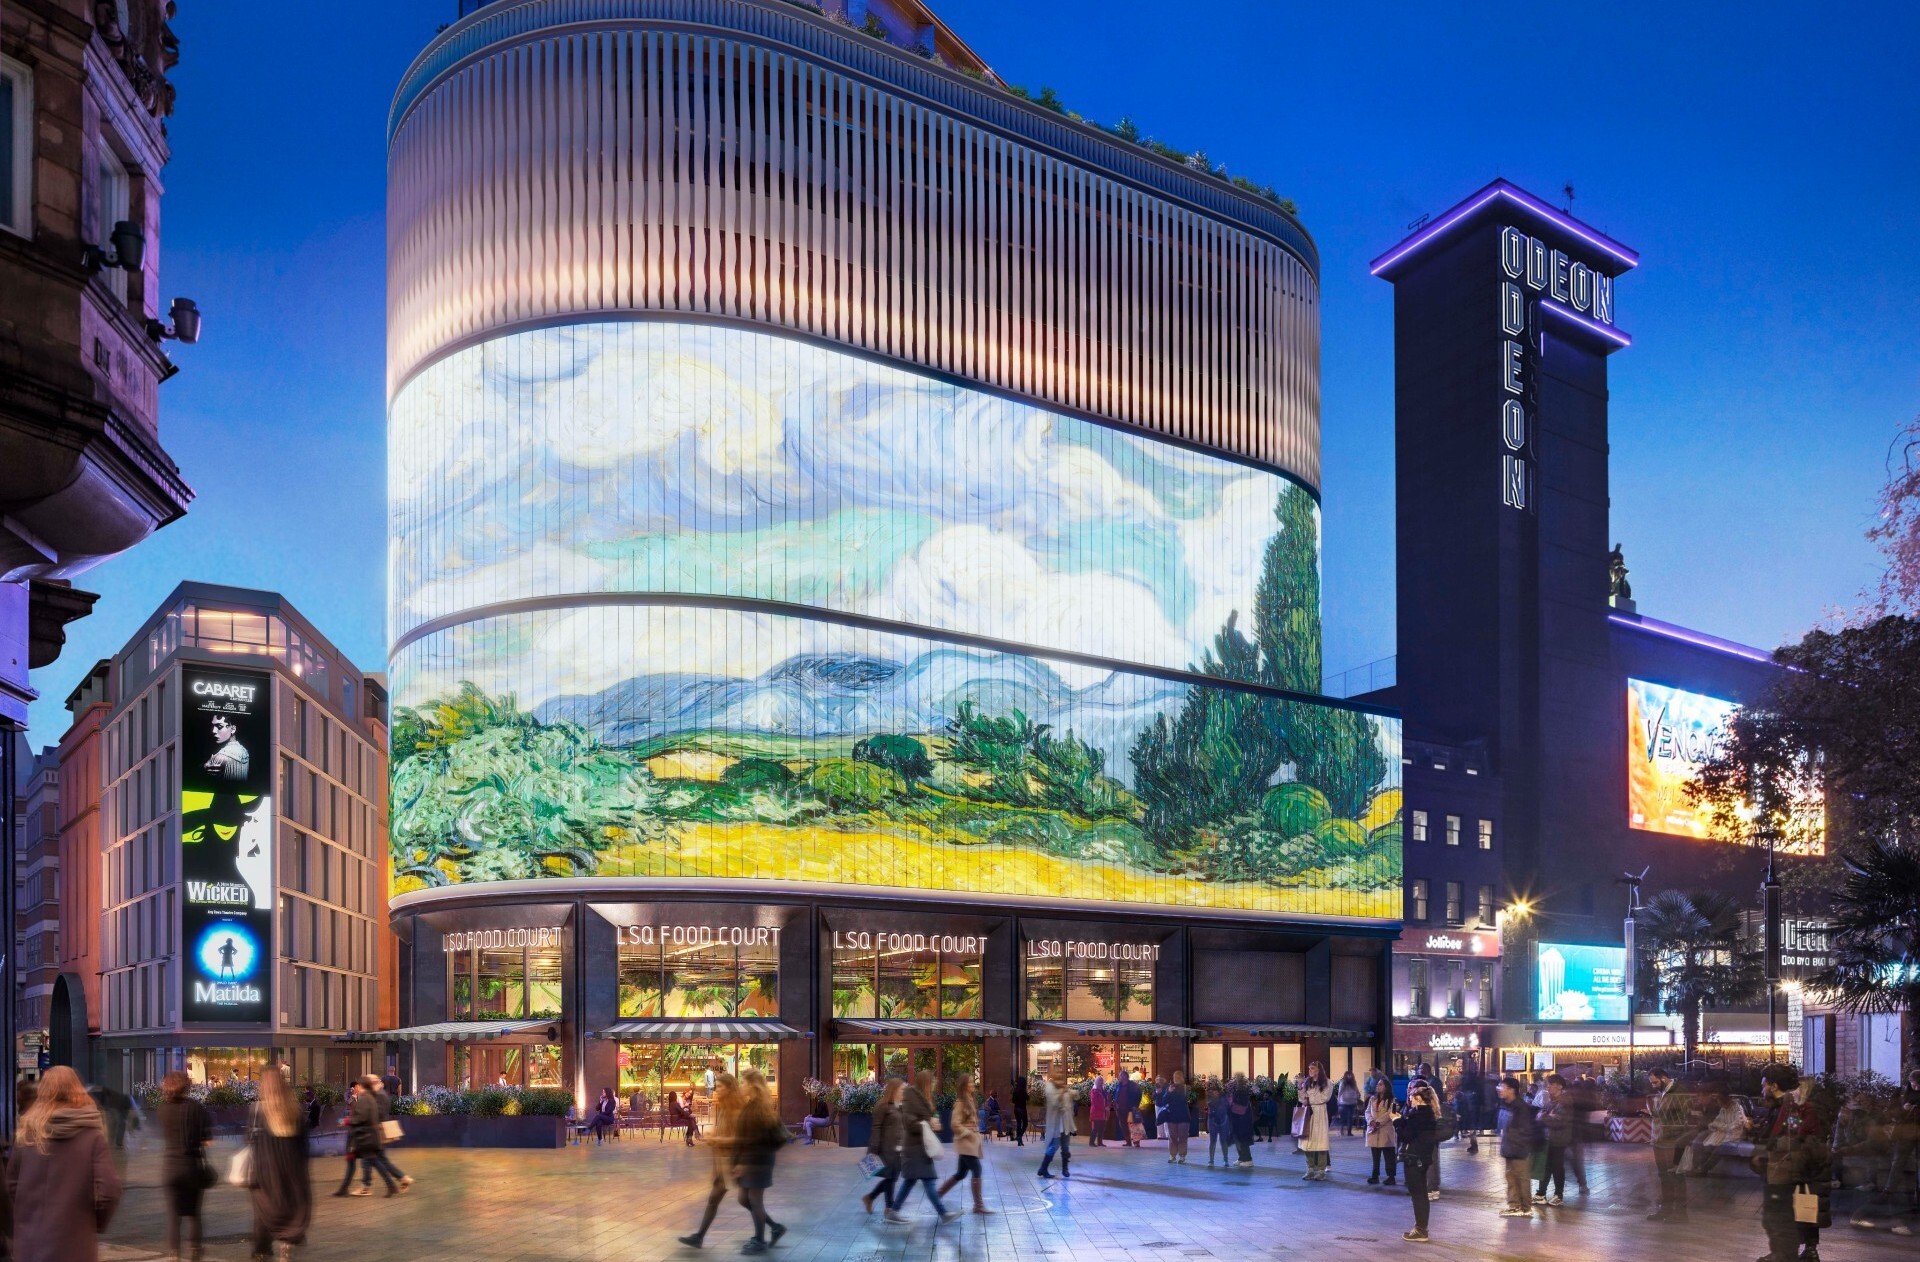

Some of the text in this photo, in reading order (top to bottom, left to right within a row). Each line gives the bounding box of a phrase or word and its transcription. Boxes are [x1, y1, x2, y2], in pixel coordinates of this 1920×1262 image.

[1502, 226, 1612, 324] ODEON
[193, 681, 256, 699] CABARET
[1647, 706, 1718, 764] VENOM
[443, 927, 562, 952] LSQ FOOD COURT
[617, 925, 780, 946] LSQ FOOD COURT
[834, 931, 987, 954] LSQ FOOD COURT
[1426, 935, 1462, 950] Jollibee
[1028, 939, 1160, 961] LSQ FOOD COURT
[195, 982, 260, 1002] Matilda
[1429, 1033, 1465, 1048] Jollibee
[1592, 1035, 1626, 1043] BOOK NOW
